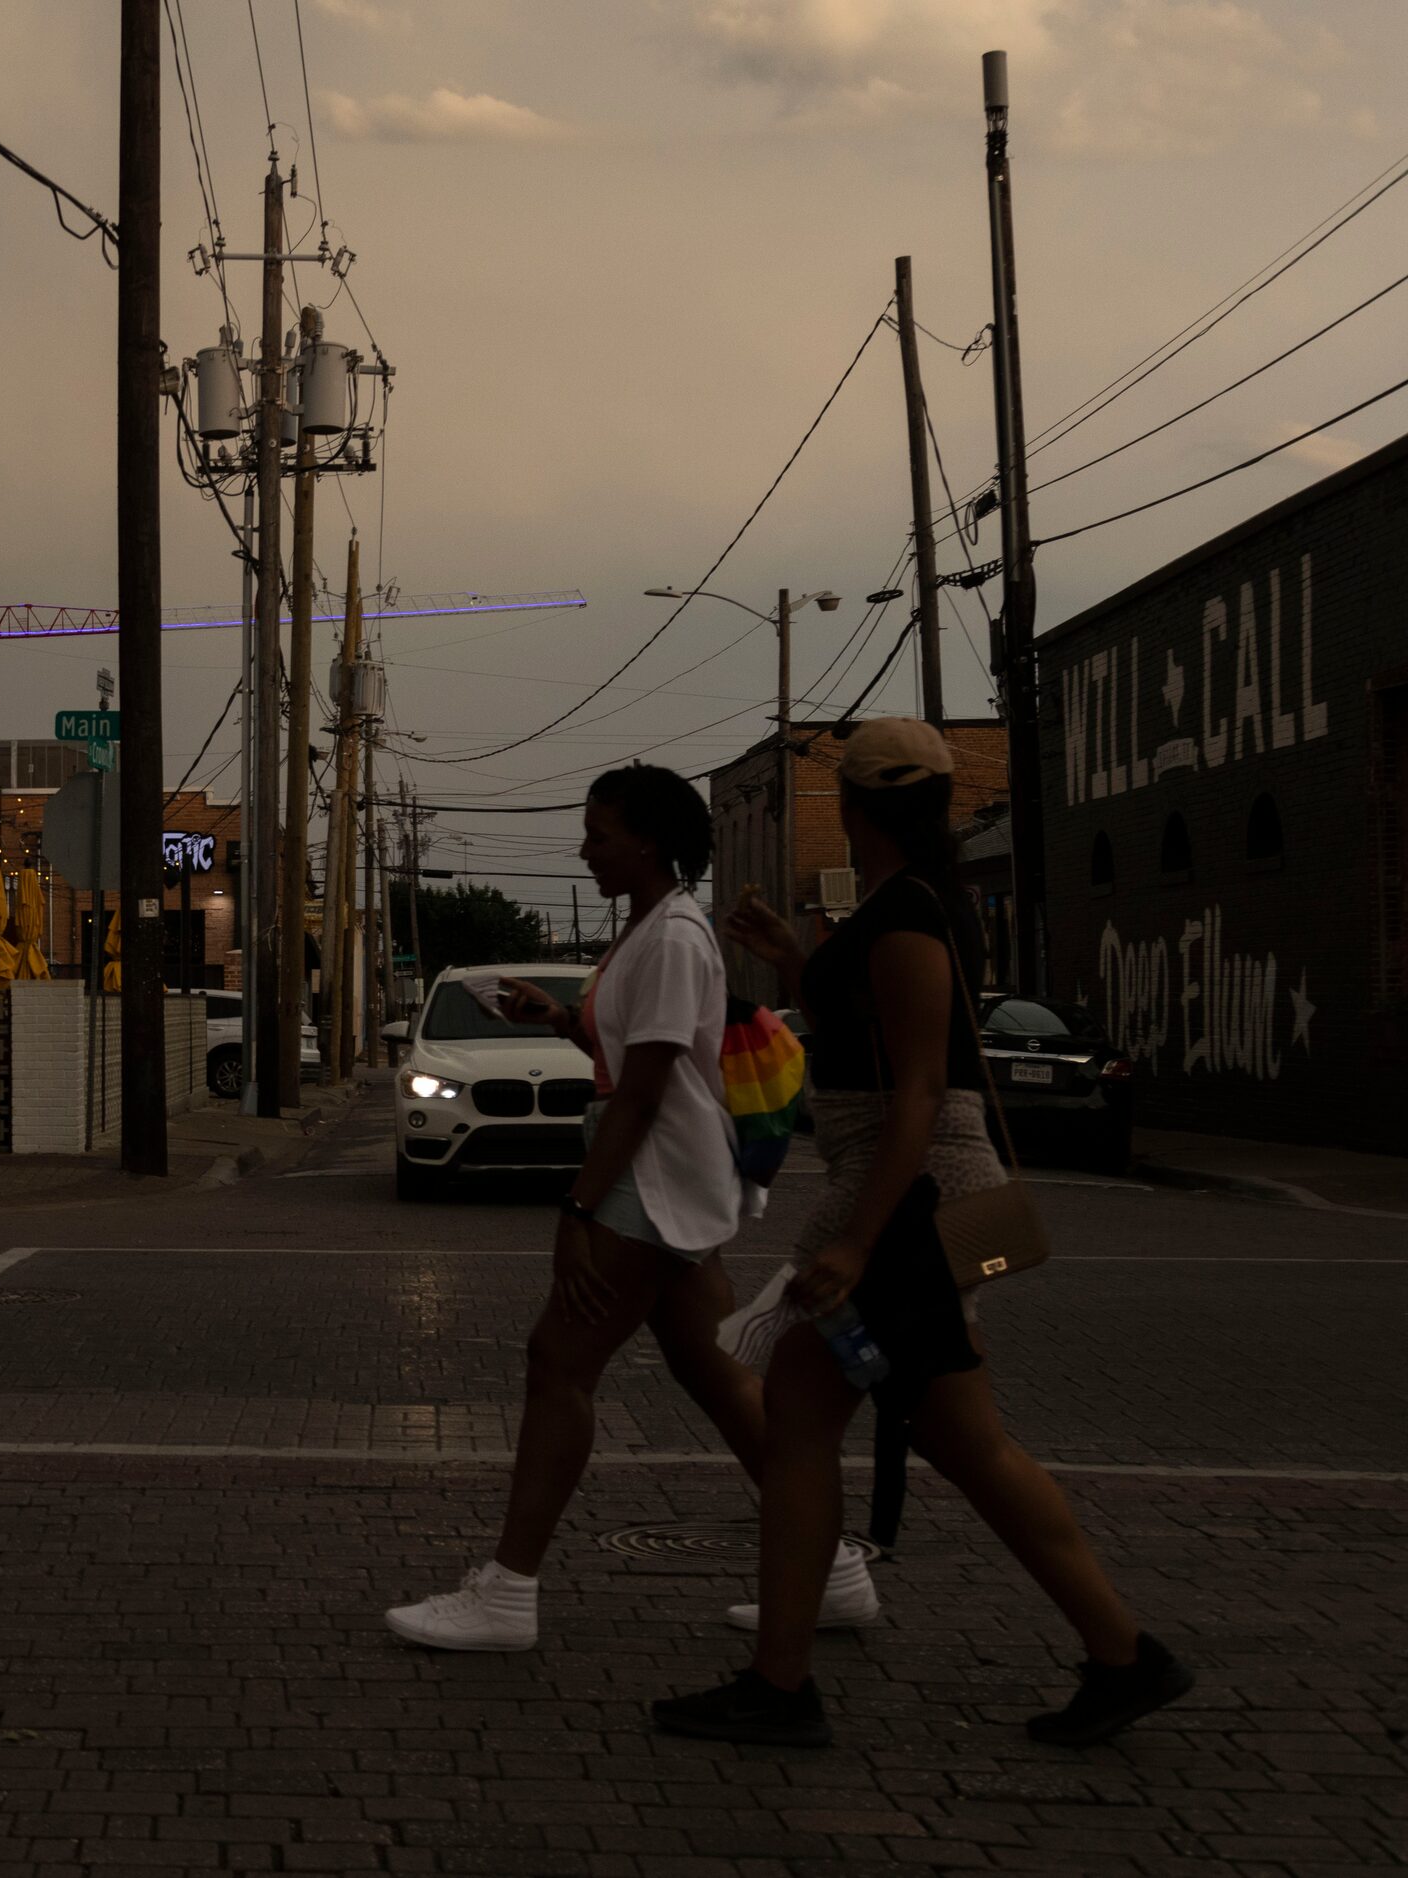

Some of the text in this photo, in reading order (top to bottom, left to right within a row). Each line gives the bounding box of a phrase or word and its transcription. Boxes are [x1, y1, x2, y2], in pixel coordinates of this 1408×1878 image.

[61, 713, 112, 737] Main
[1063, 552, 1329, 807] WILL CALL
[1099, 903, 1281, 1081] Deep Ellum
